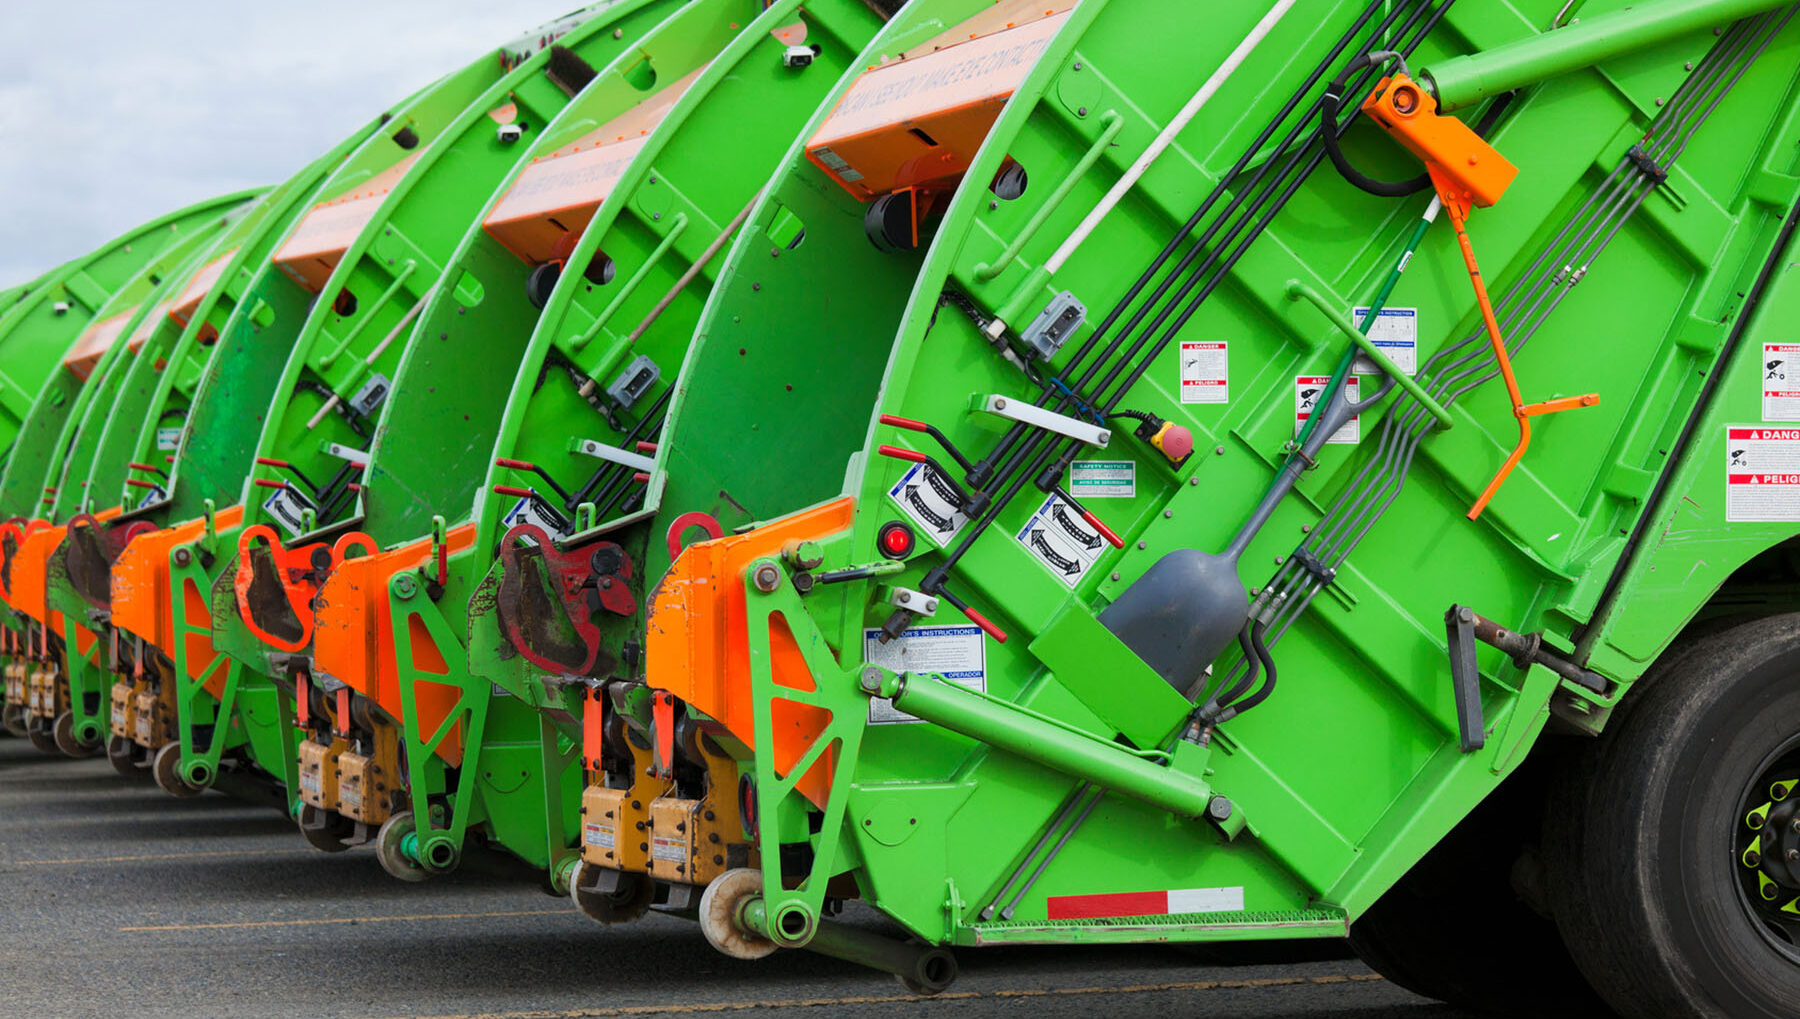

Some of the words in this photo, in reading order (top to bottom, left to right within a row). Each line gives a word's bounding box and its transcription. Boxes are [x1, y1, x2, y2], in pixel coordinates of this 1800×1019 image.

[1763, 430, 1800, 440] DANG
[1763, 475, 1800, 484] PELIG
[921, 628, 976, 637] INSTRUCTIONS
[948, 671, 981, 679] OPERADOR
